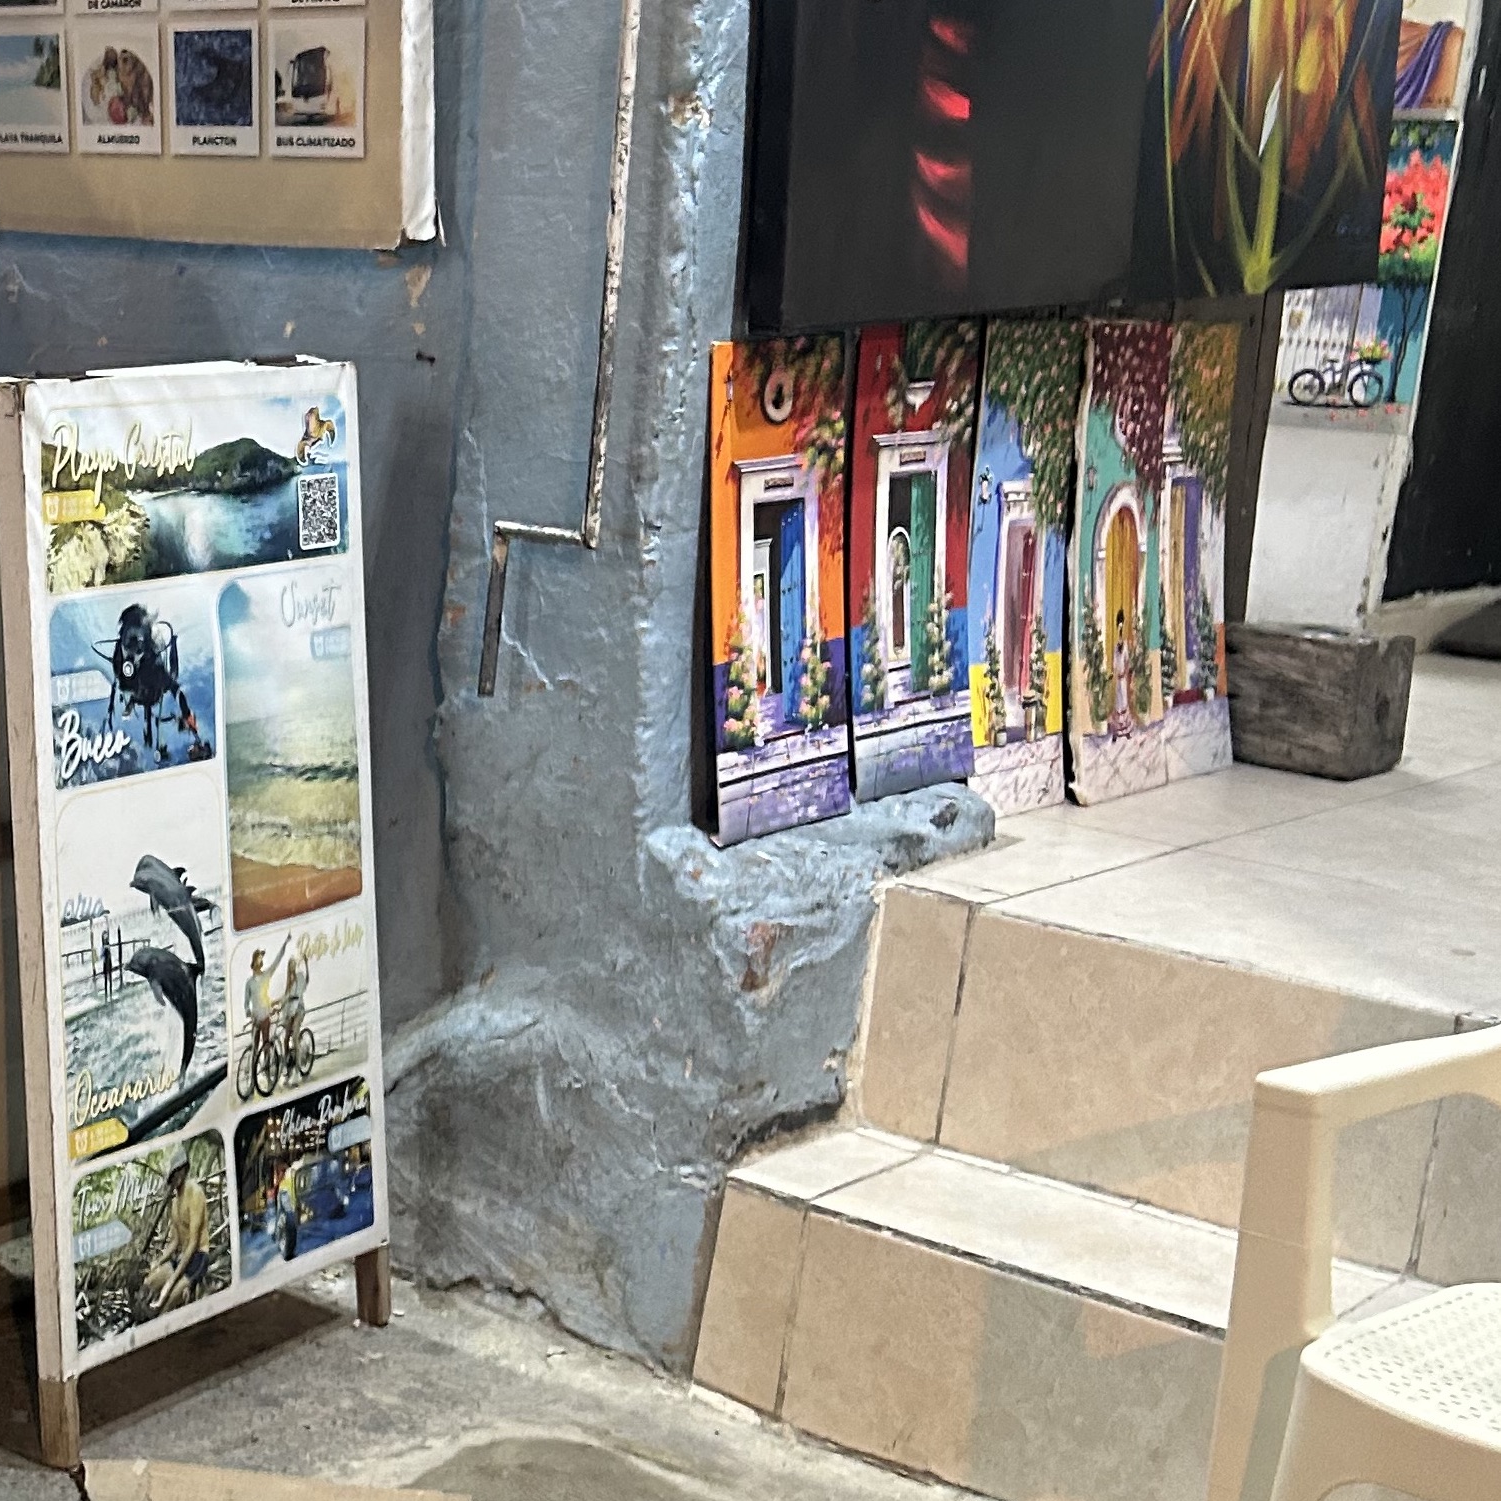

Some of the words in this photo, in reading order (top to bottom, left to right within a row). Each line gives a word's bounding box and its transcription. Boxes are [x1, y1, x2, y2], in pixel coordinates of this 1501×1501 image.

[20, 133, 63, 145] TRANQUILA
[97, 135, 140, 144] ALMUERZO
[192, 136, 237, 146] PLANCTON
[276, 136, 294, 146] BUS
[296, 136, 356, 147] CLIMATIZADO
[51, 420, 118, 508] Playa
[124, 417, 197, 480] Cristal
[58, 709, 131, 779] Buceo
[75, 1064, 178, 1127] Oceanario
